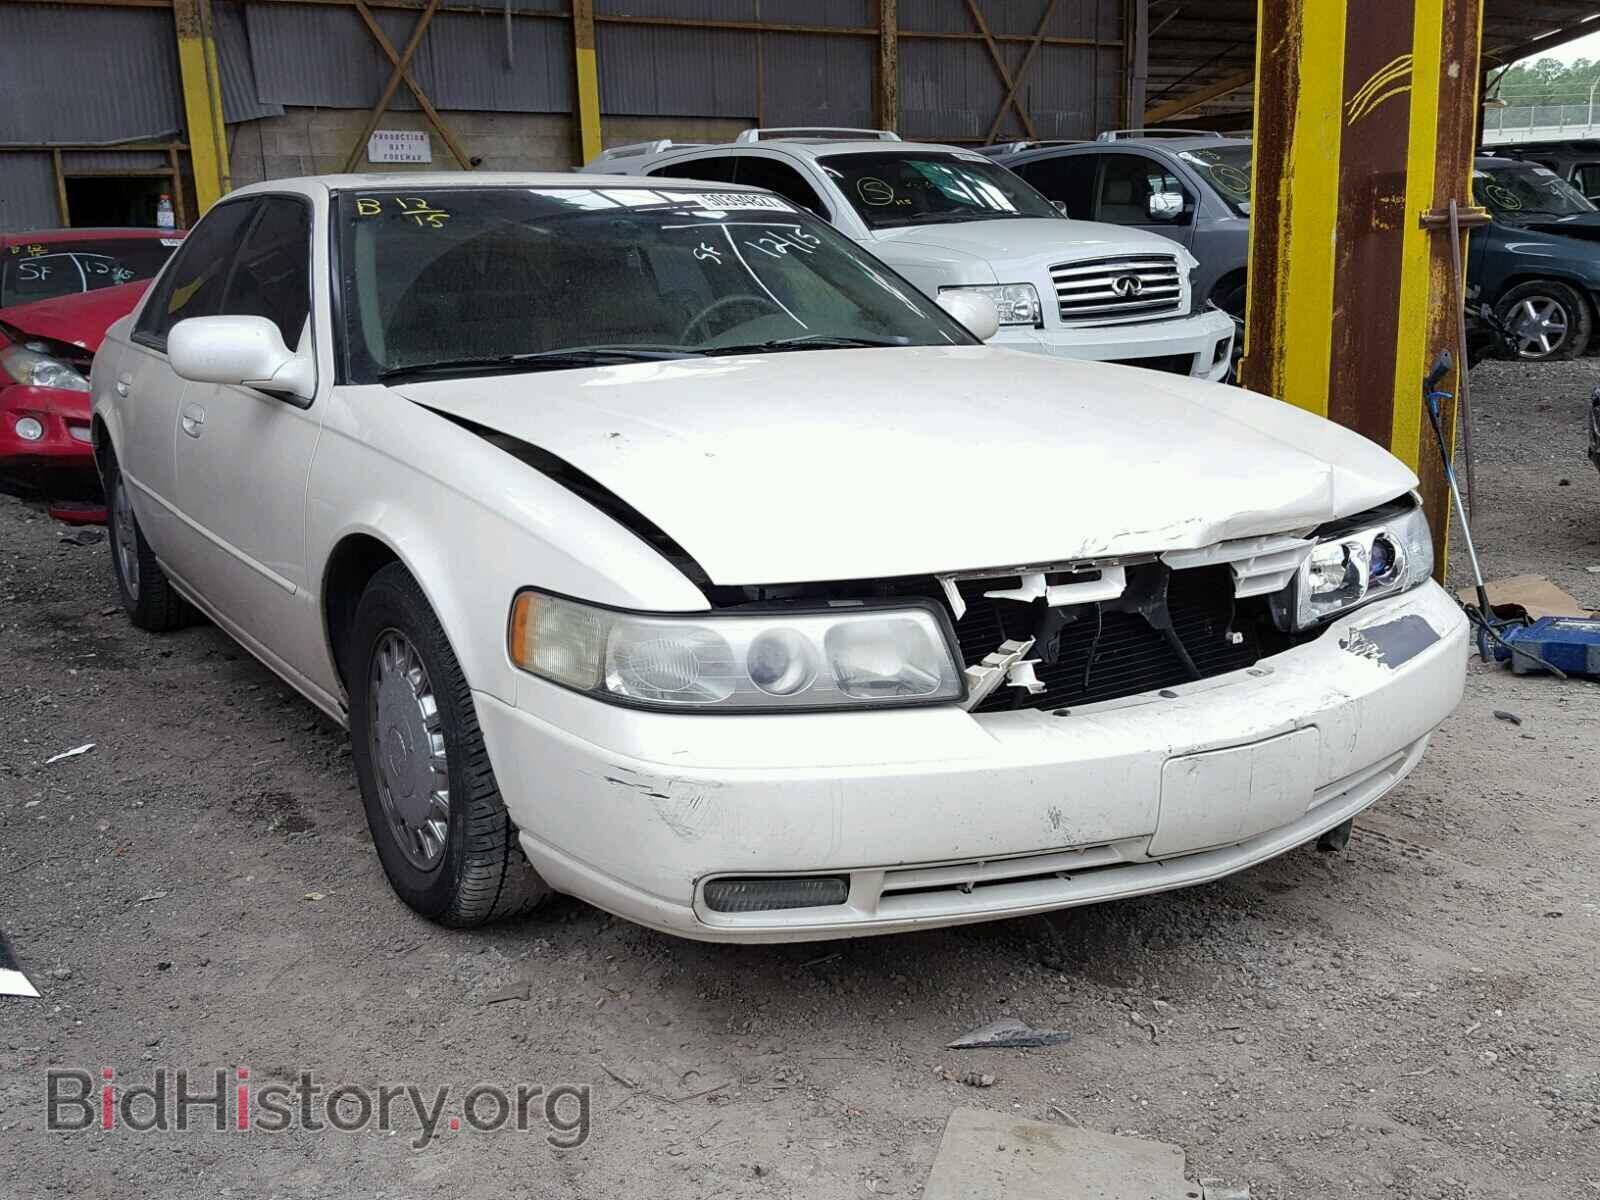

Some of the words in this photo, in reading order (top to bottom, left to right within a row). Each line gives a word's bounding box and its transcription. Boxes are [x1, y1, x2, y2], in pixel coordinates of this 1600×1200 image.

[355, 197, 384, 217] B
[692, 242, 722, 265] SF
[18, 262, 55, 281] SF
